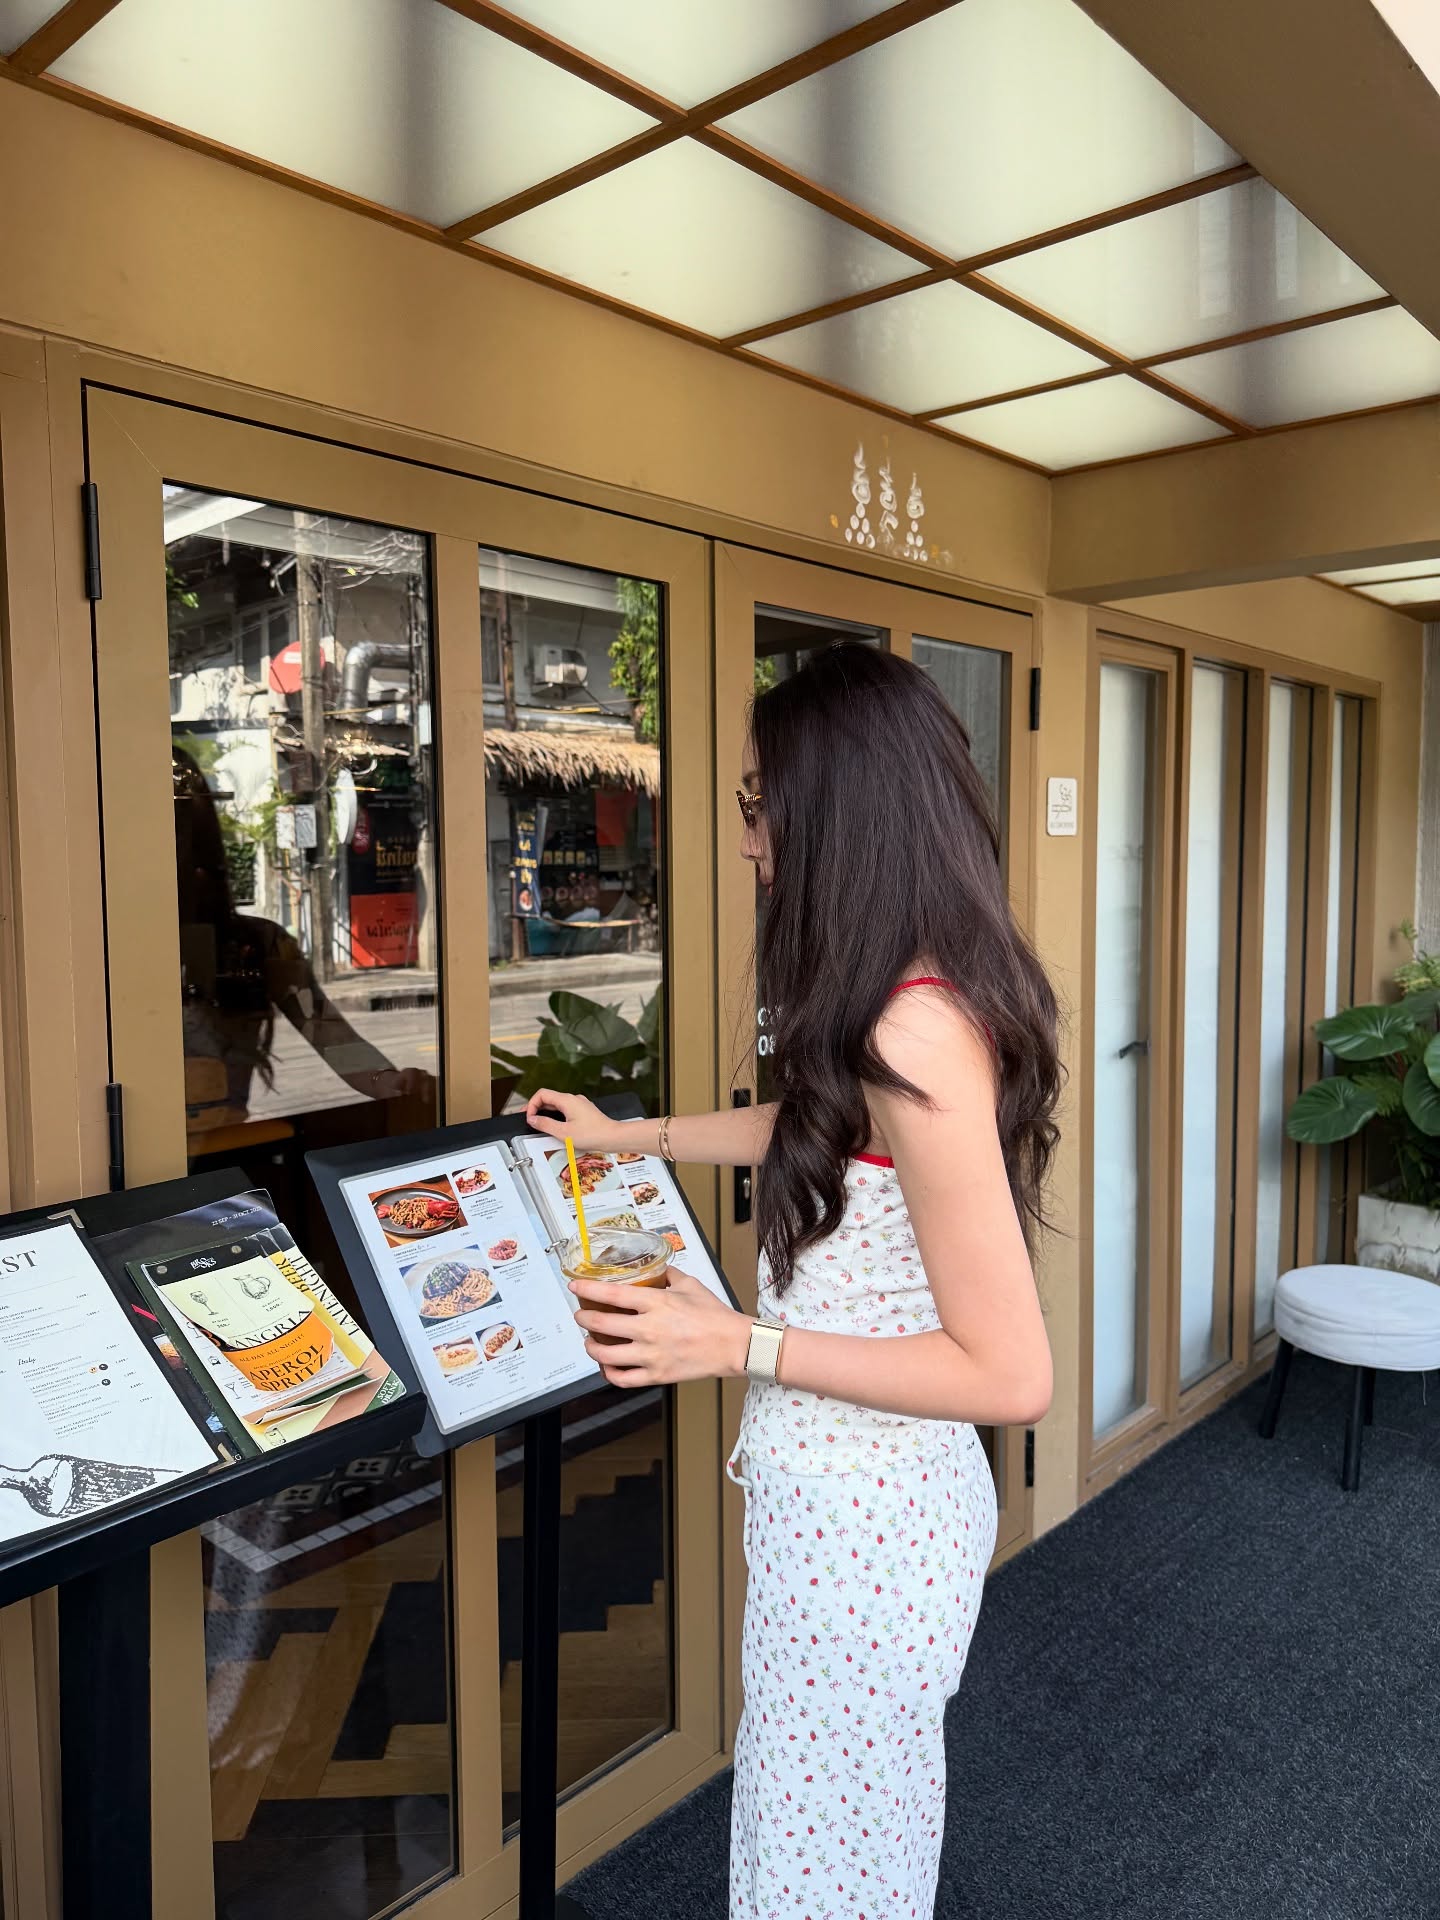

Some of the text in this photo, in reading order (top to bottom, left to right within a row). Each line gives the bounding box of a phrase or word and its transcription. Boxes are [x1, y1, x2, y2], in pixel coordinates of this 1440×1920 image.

[0, 1250, 38, 1275] ST
[276, 1257, 310, 1293] BEER
[234, 1310, 310, 1348] ANGRIA
[17, 1356, 37, 1366] Italy
[249, 1345, 324, 1381] APEROL
[377, 1380, 393, 1400] SOFT
